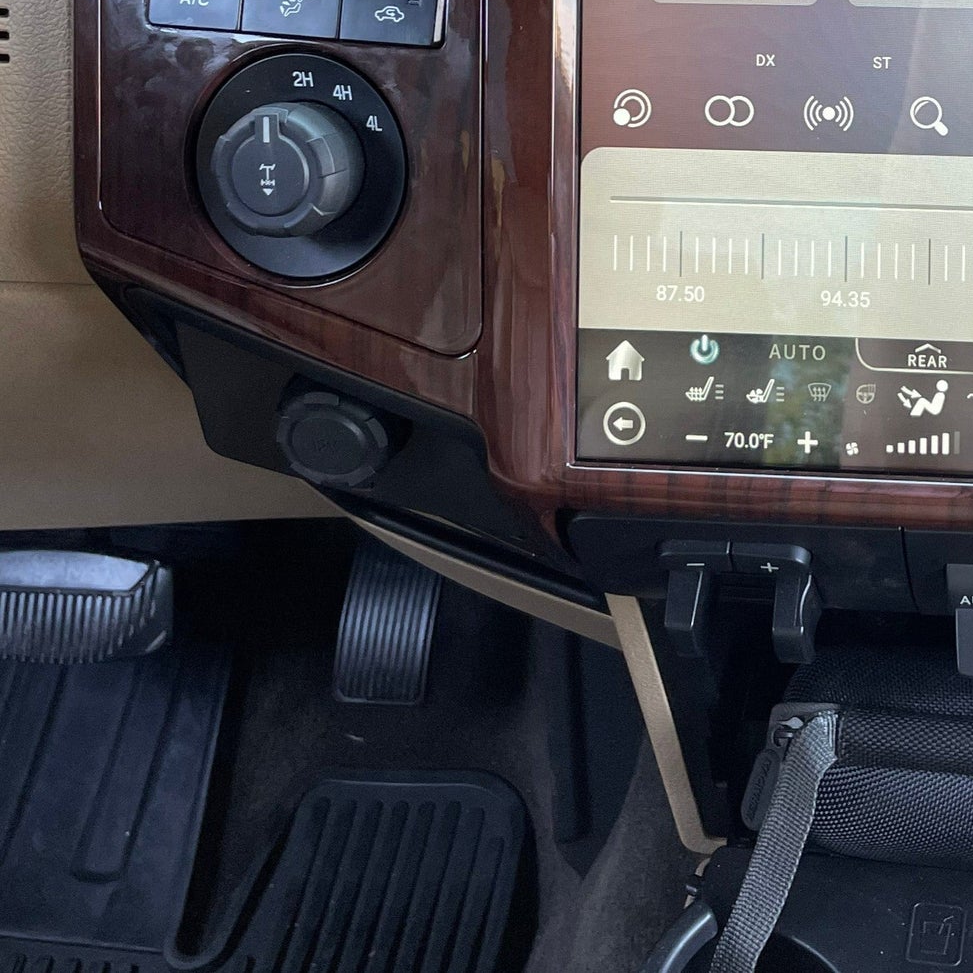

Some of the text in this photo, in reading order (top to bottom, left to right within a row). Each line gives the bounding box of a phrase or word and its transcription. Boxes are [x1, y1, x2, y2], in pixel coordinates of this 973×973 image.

[755, 53, 776, 67] DX
[872, 55, 892, 70] ST
[292, 71, 315, 88] 2H
[332, 83, 353, 102] 4H
[365, 114, 383, 132] 4L
[656, 285, 705, 303] 87.50
[820, 290, 871, 309] 94.35
[768, 343, 827, 362] AUTO
[906, 352, 949, 370] REAR
[723, 430, 774, 450] 70.0°F
